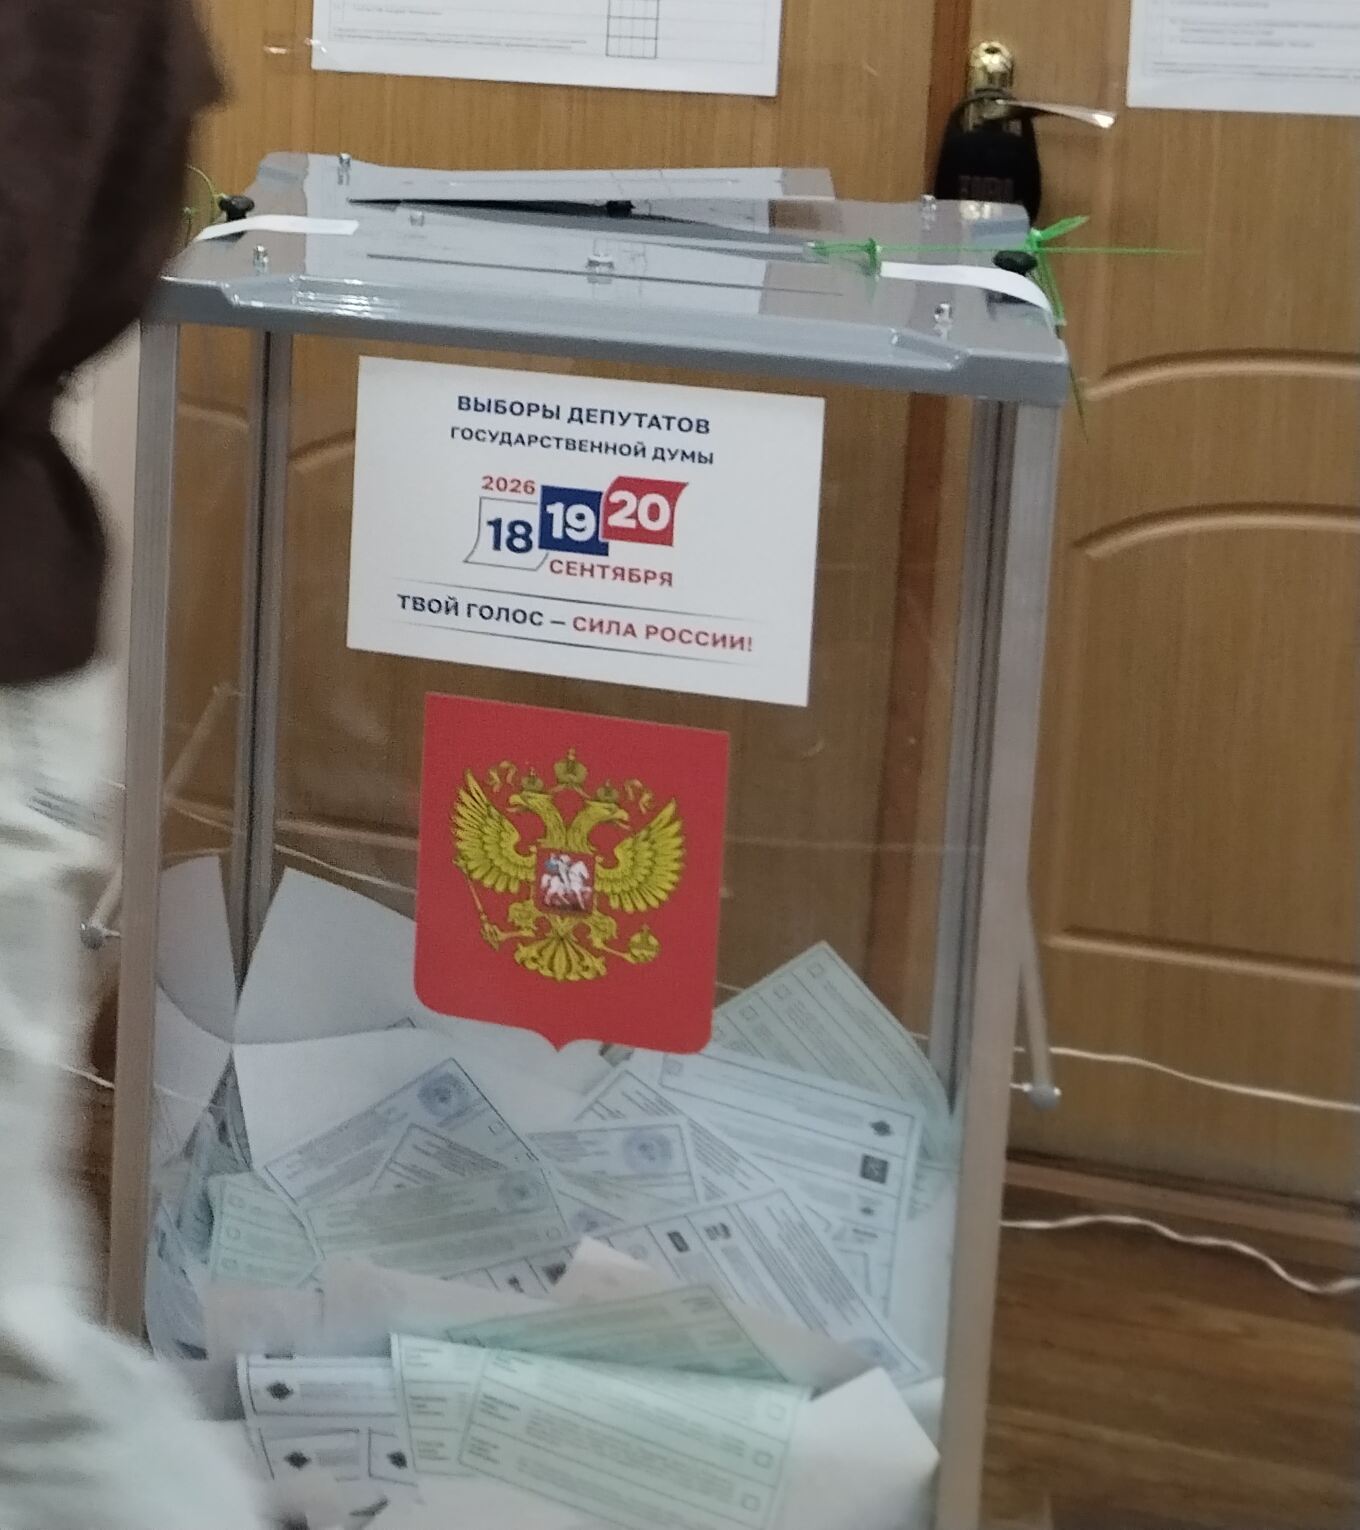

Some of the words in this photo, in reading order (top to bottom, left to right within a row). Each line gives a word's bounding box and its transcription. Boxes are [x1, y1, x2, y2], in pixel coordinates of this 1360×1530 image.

[457, 395, 562, 422] ВЫБОРЫ
[566, 405, 711, 435] ДЕПУТАТОВ
[450, 426, 647, 459] ГОСУДАРСТВЕННОЙ
[651, 444, 715, 466] ДУМЫ
[480, 475, 537, 496] 2026
[486, 517, 534, 555] 18
[545, 501, 597, 543] 19
[606, 488, 671, 532] 20
[548, 558, 675, 589] СЕНТЯБРЯ
[396, 592, 460, 618] ТВОЙ
[466, 602, 544, 628] ГОЛОС
[572, 615, 638, 639] СИЛА
[644, 624, 754, 653] РОССИИ!
